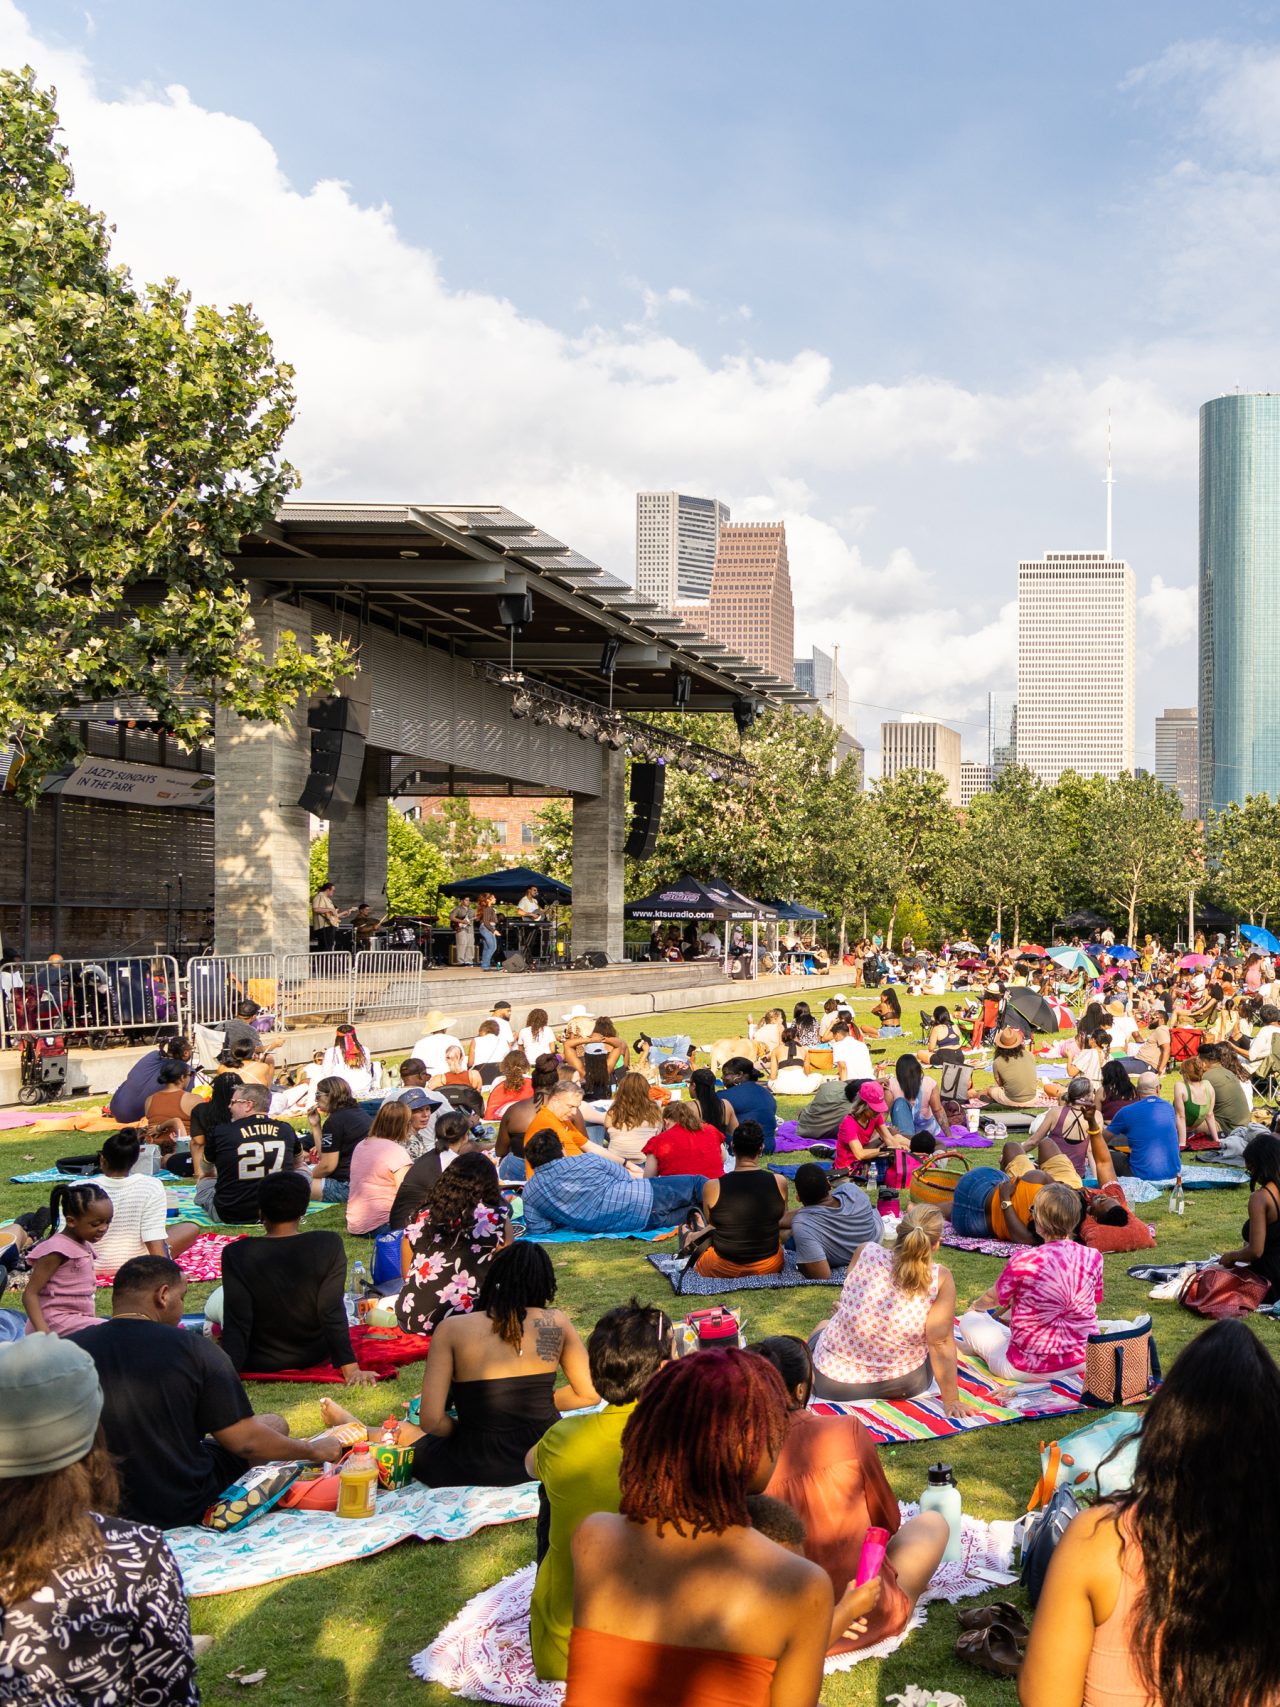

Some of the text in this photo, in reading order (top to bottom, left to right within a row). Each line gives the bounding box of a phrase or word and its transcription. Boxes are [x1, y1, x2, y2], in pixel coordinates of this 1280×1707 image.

[85, 767, 115, 779] JAZZY
[117, 772, 158, 784] SUNDAYS
[76, 777, 136, 793] IN THE PARK
[632, 910, 715, 919] www.ktsuradio.com
[240, 1124, 280, 1138] ALTUVE
[237, 1140, 286, 1180] 27
